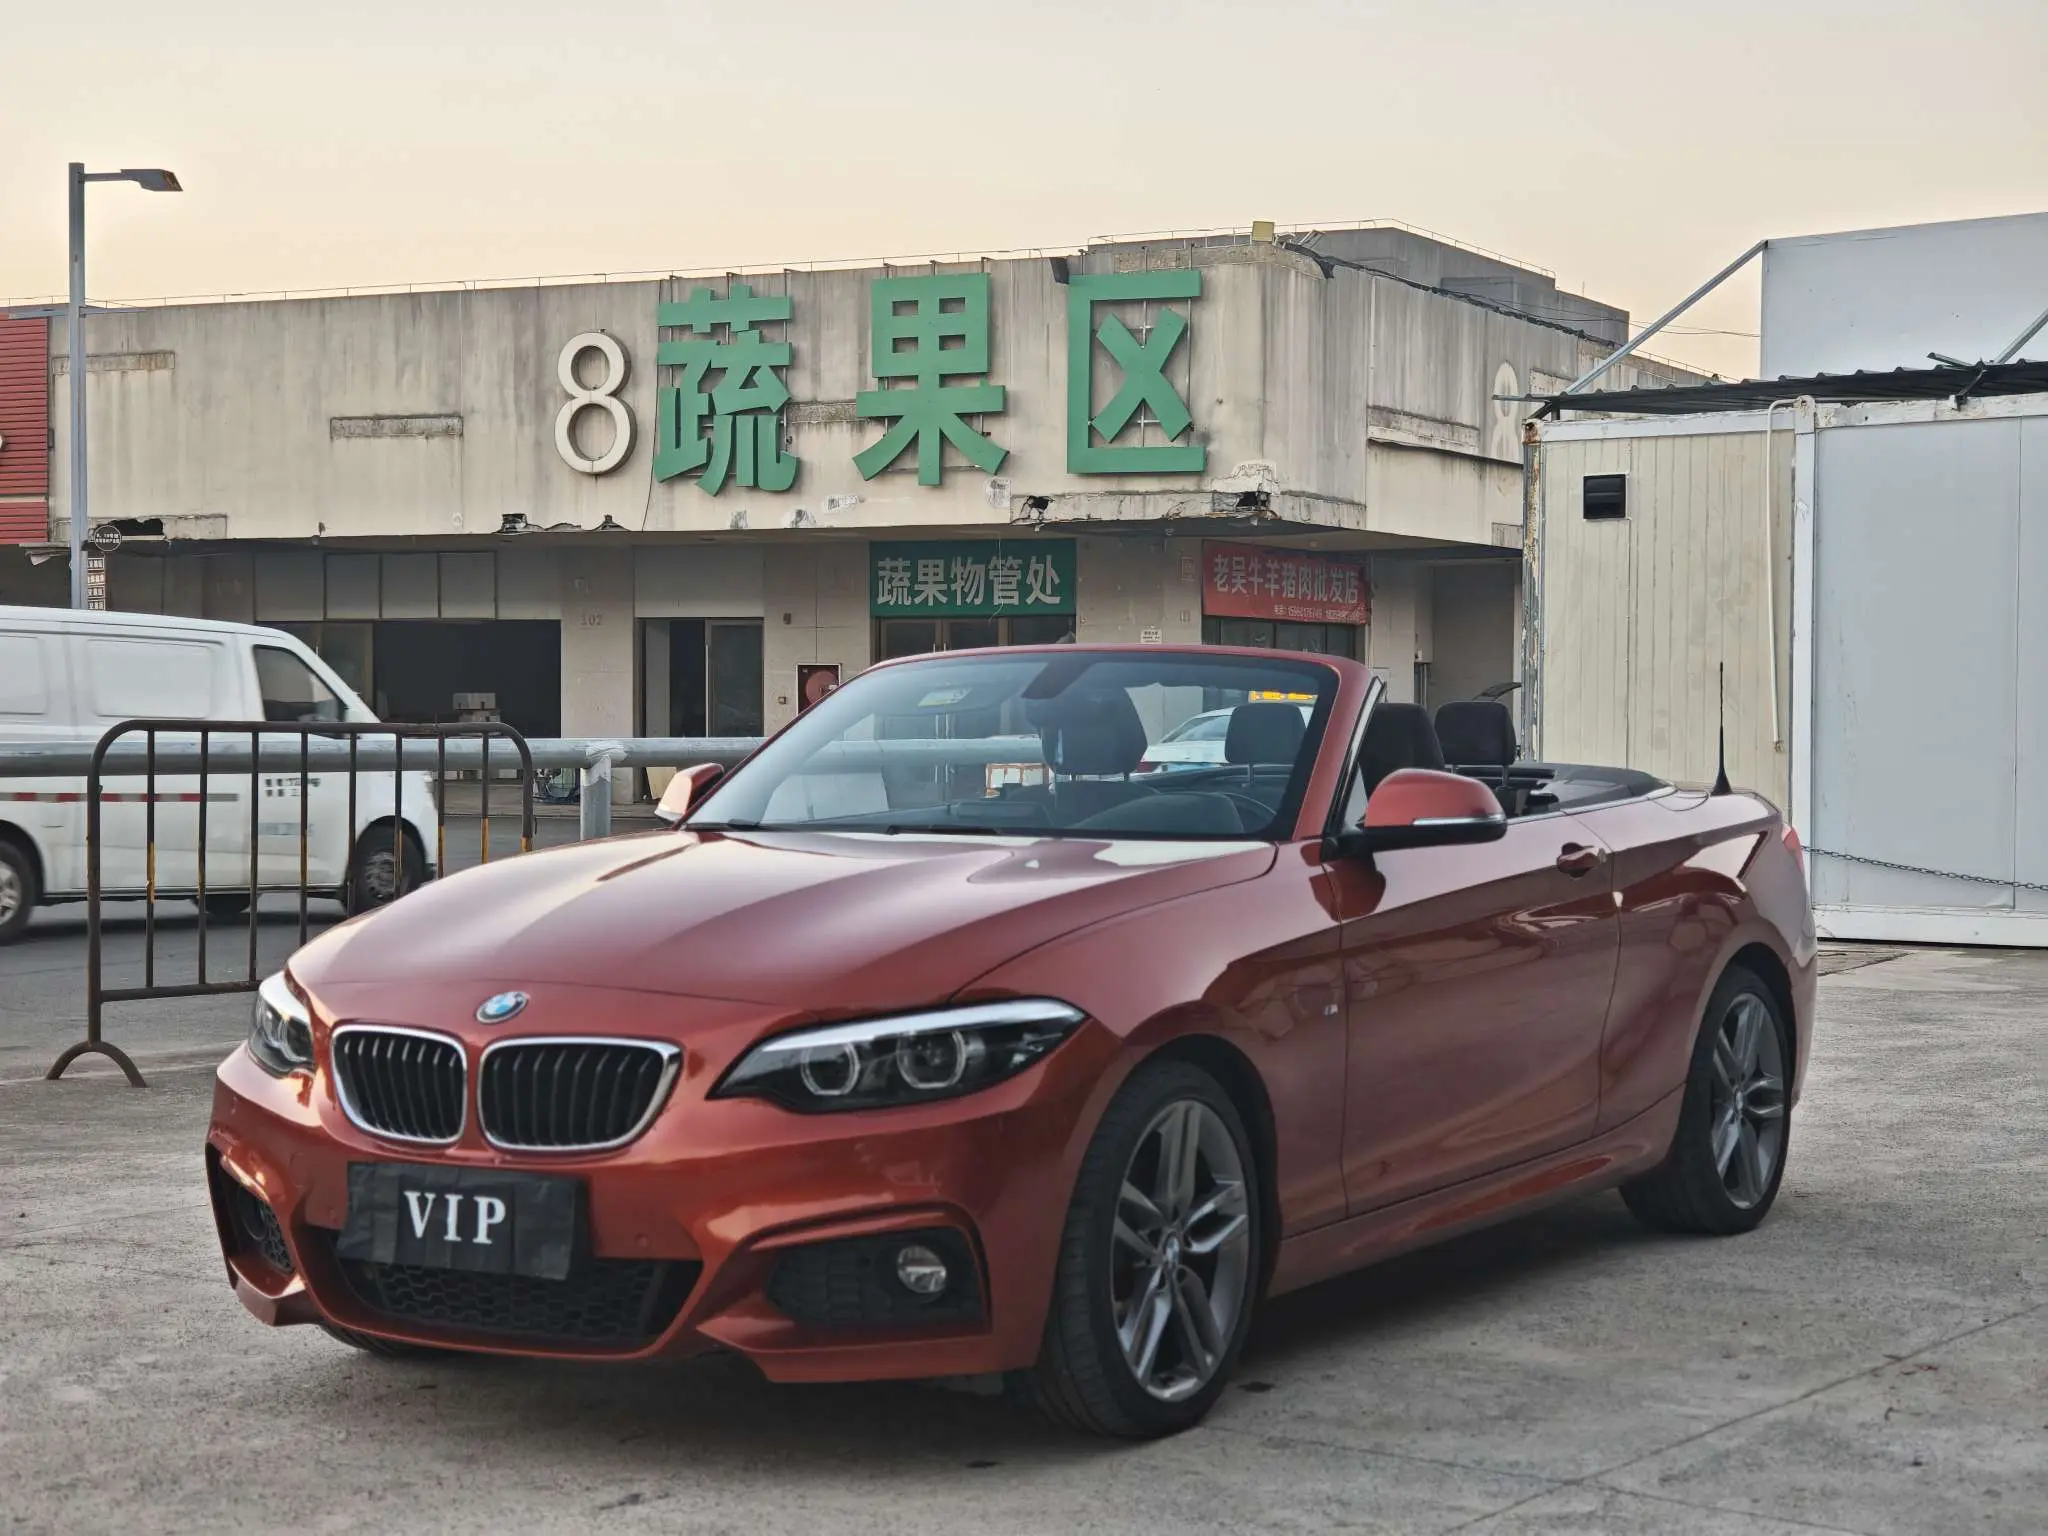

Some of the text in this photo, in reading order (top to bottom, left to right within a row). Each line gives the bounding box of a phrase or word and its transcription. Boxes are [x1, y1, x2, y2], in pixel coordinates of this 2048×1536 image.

[554, 331, 637, 475] 8
[653, 270, 1206, 497] 蔬果区
[877, 555, 1061, 606] 蔬果物管处
[1213, 553, 1359, 605] 老吴牛羊猪肉批发店
[404, 1190, 506, 1245] VIP
